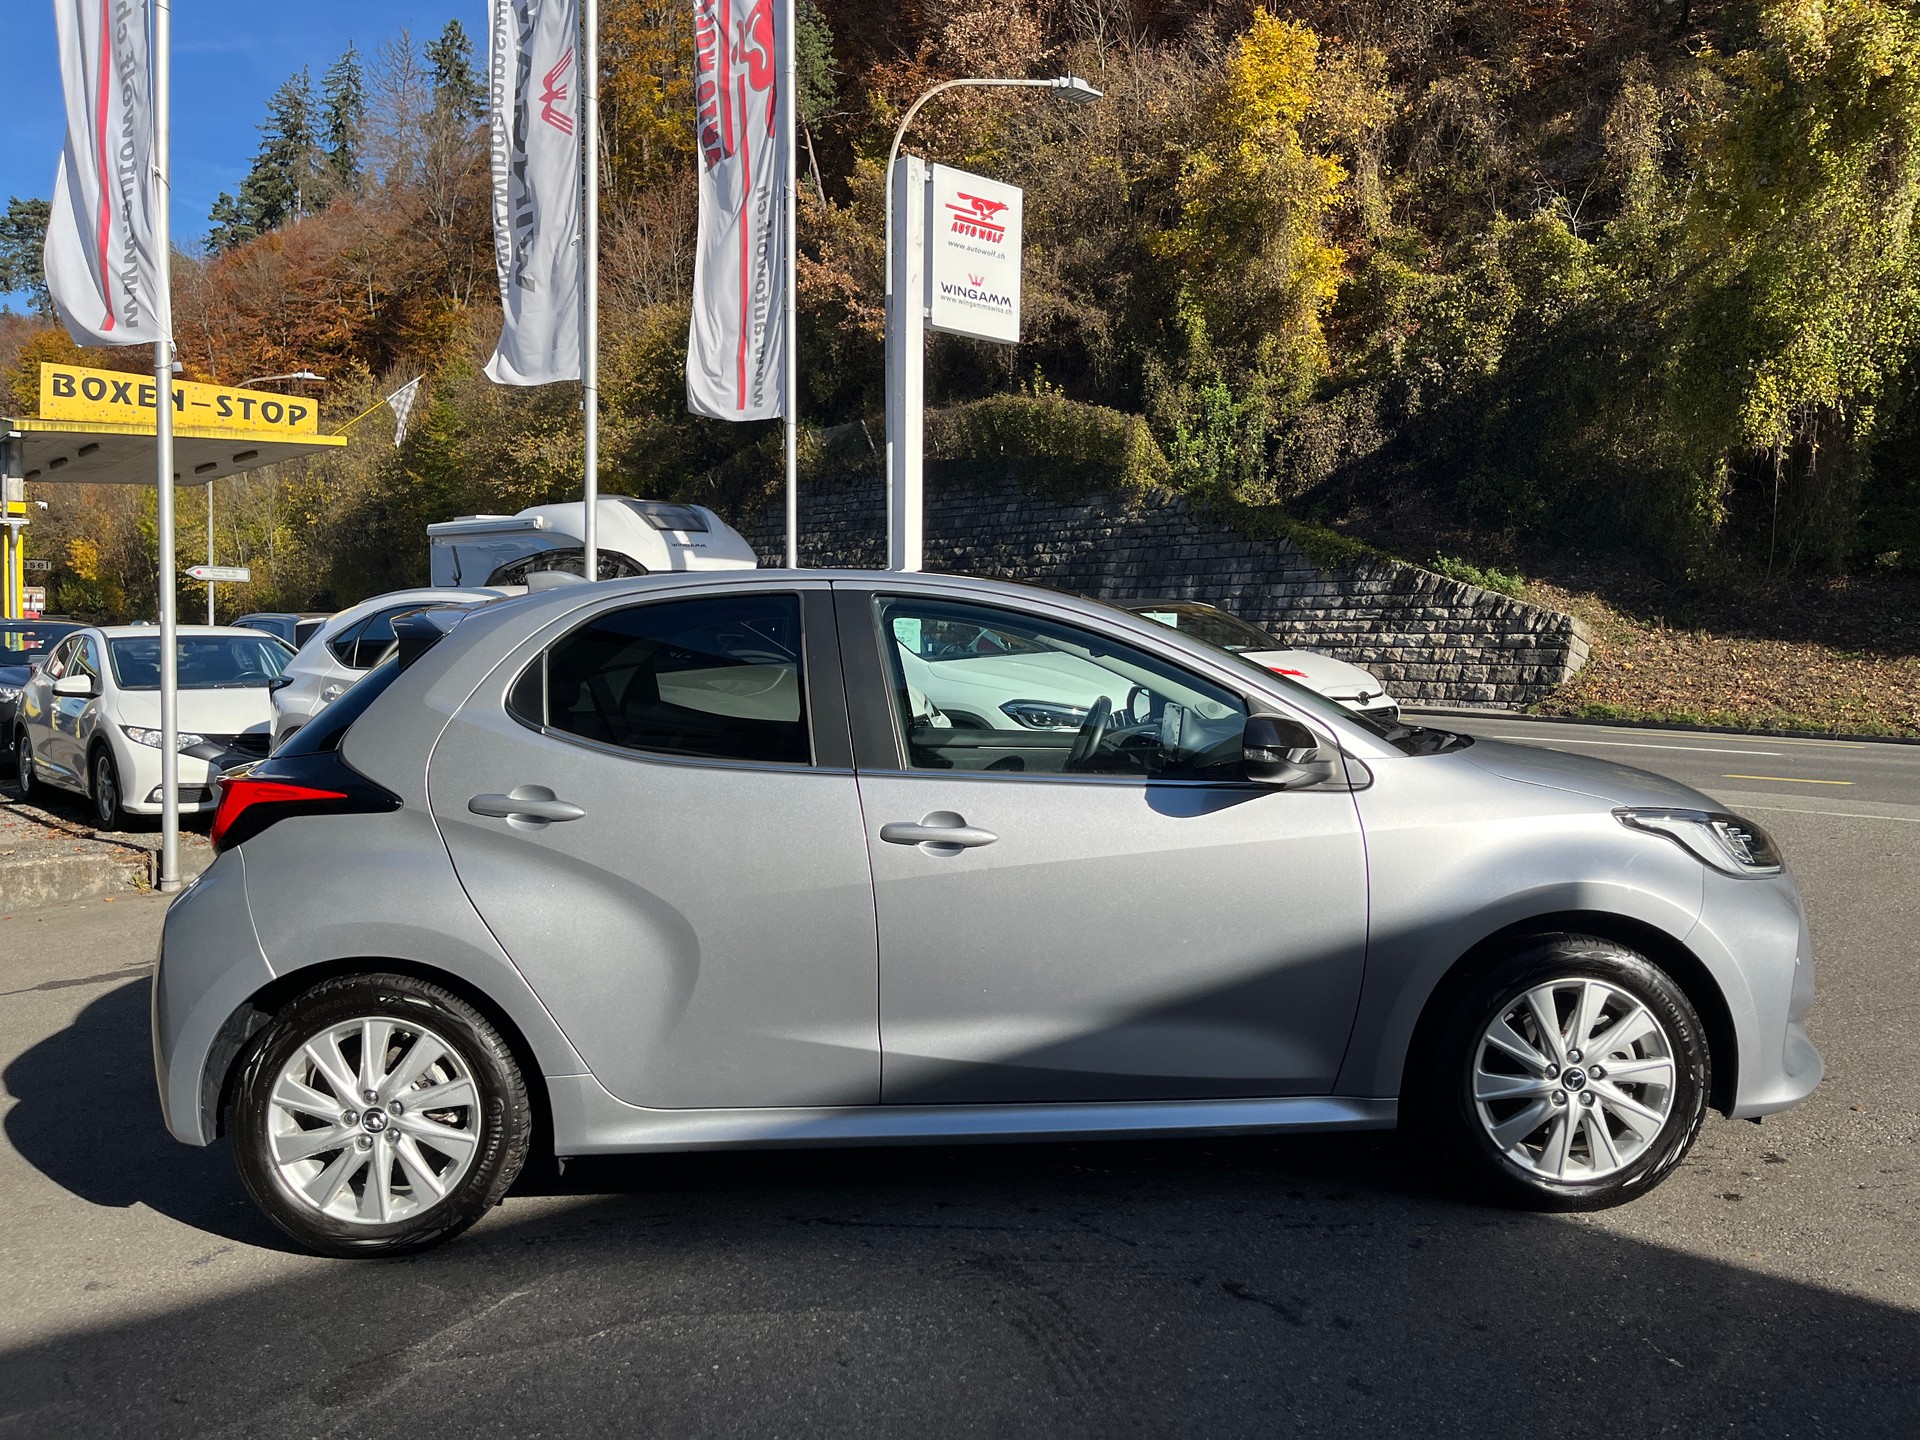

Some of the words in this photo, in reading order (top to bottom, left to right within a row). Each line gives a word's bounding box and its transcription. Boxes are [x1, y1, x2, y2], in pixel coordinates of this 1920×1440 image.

[951, 222, 976, 237] AUTO
[979, 228, 1004, 243] WOLF
[948, 241, 1005, 259] www.autowolf.ch
[941, 282, 1012, 307] WINGAMM
[940, 295, 1012, 315] www.wingammswiss.ch
